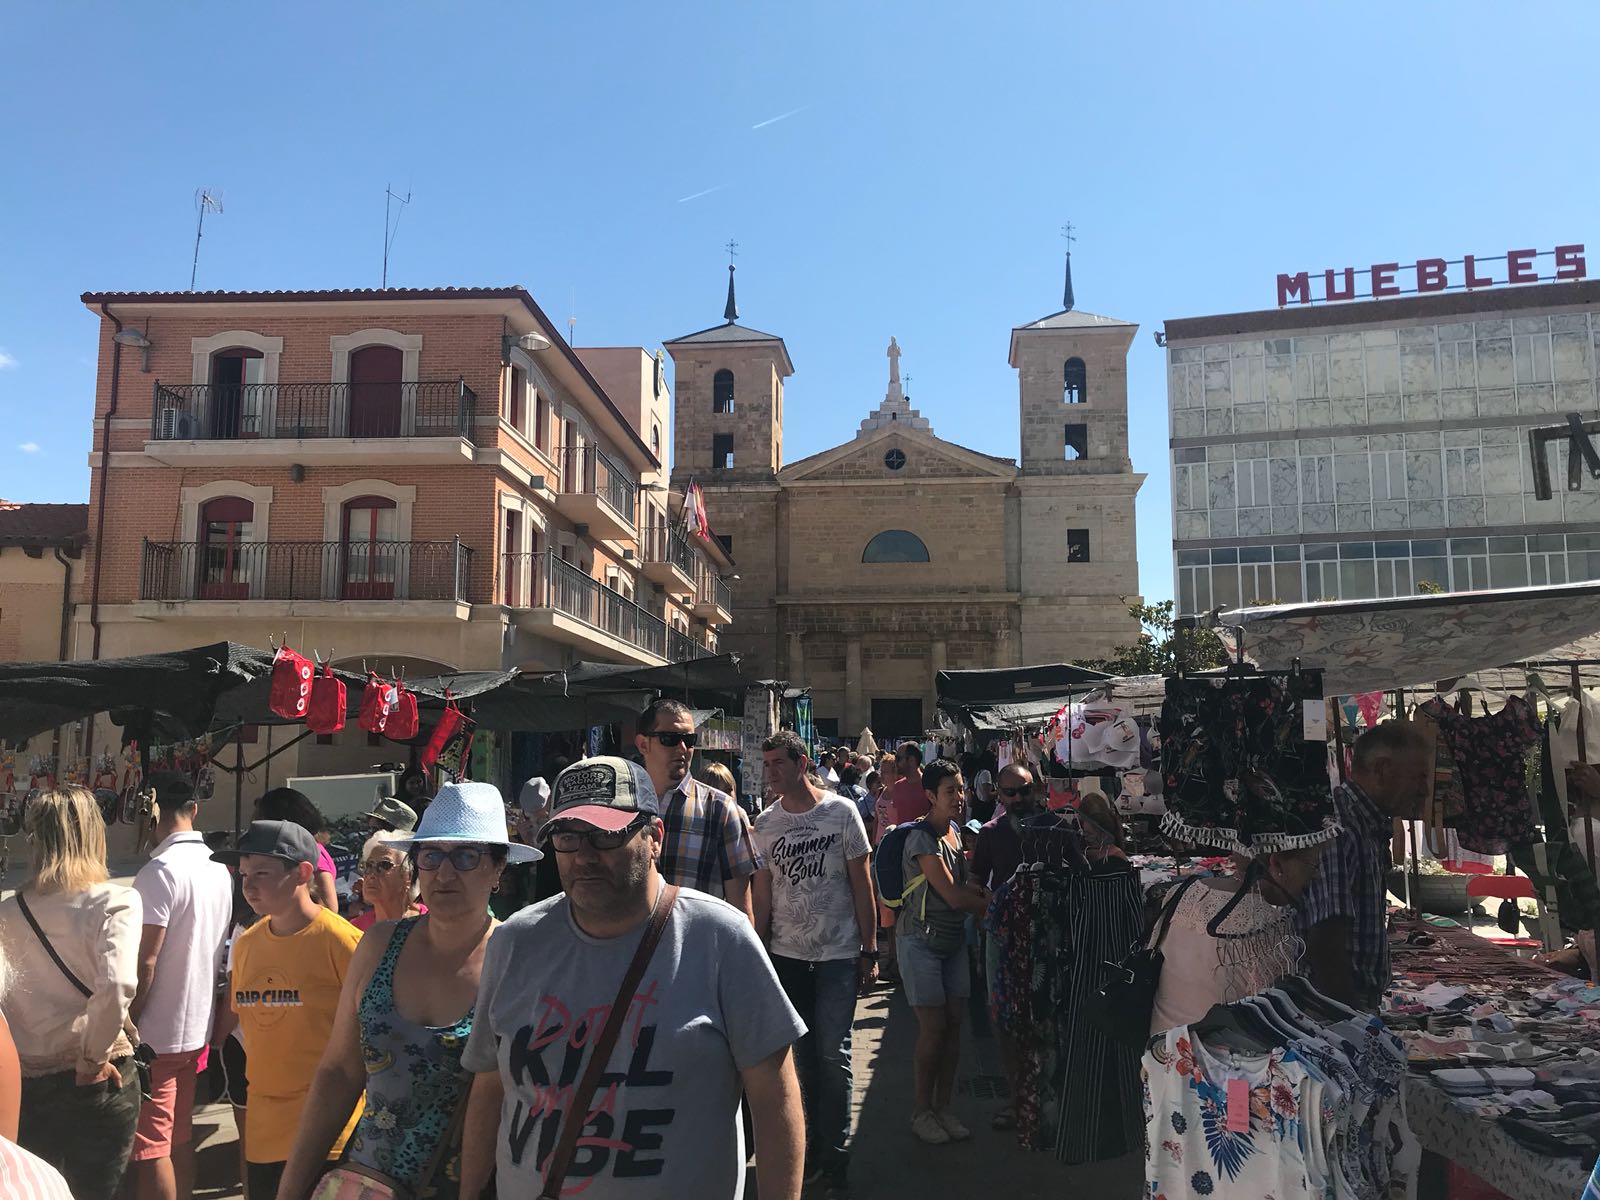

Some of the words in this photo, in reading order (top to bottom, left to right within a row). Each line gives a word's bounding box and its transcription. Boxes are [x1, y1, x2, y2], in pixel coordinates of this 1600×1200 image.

[1277, 244, 1586, 306] MUEBLES
[564, 771, 604, 785] MOTORS
[566, 778, 601, 788] RACING
[569, 783, 597, 792] TEAM
[772, 833, 839, 866] Summer
[788, 853, 826, 886] Soul
[236, 991, 260, 1008] RIP
[262, 990, 303, 1008] CURL
[509, 1100, 675, 1178] VIBE
